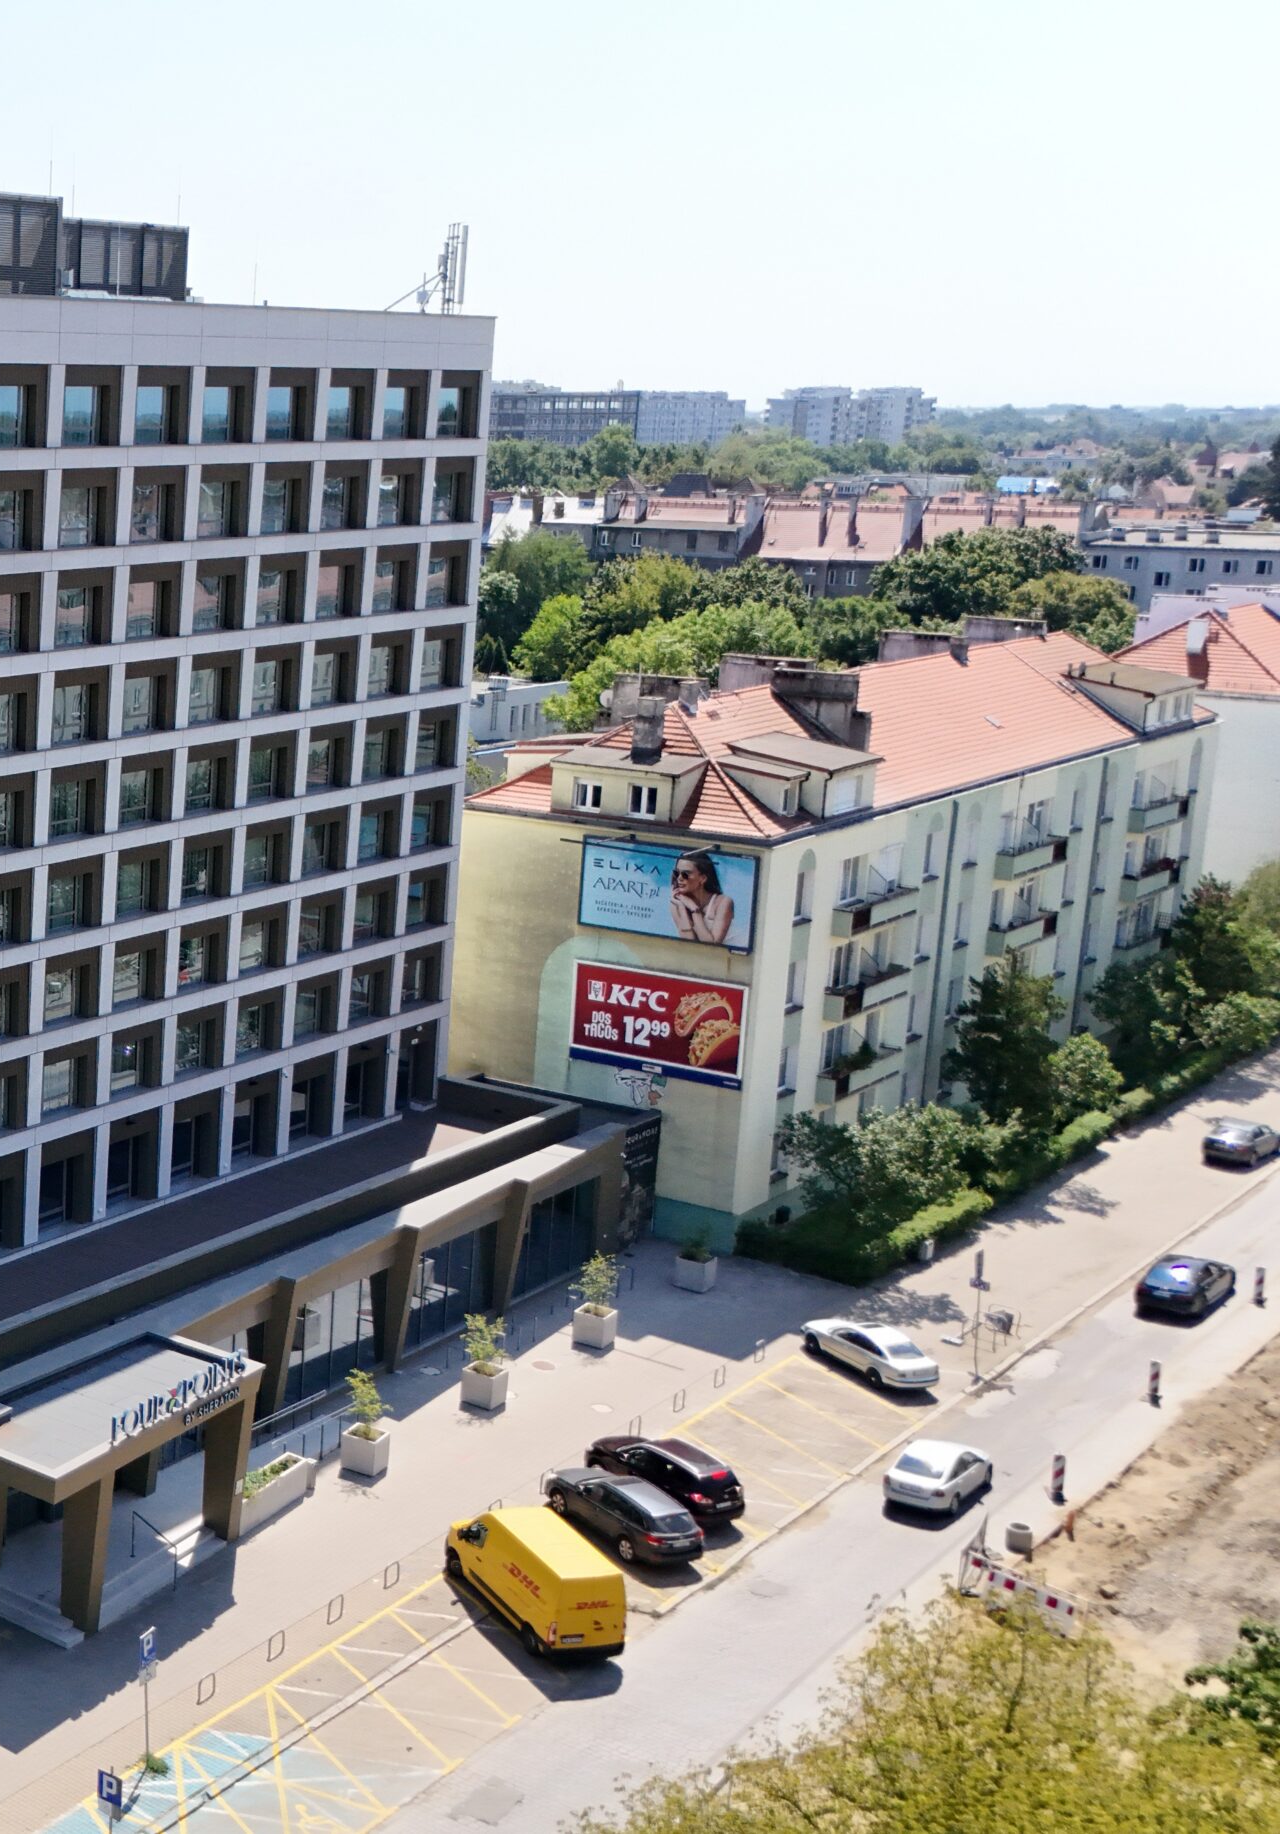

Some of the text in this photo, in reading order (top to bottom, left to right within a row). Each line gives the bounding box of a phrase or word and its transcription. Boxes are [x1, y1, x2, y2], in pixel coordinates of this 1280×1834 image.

[593, 858, 661, 876] ELIXA
[592, 877, 660, 899] APART.pl
[607, 984, 669, 1012] KFC
[592, 1011, 612, 1025] DOS
[584, 1023, 618, 1040] TACOS
[111, 1349, 247, 1443] FOUR POINTS
[183, 1386, 241, 1427] BY SHERATON
[508, 1562, 541, 1599] DHL
[575, 1600, 608, 1610] DHL
[143, 1633, 153, 1658] P
[102, 1773, 117, 1798] P
